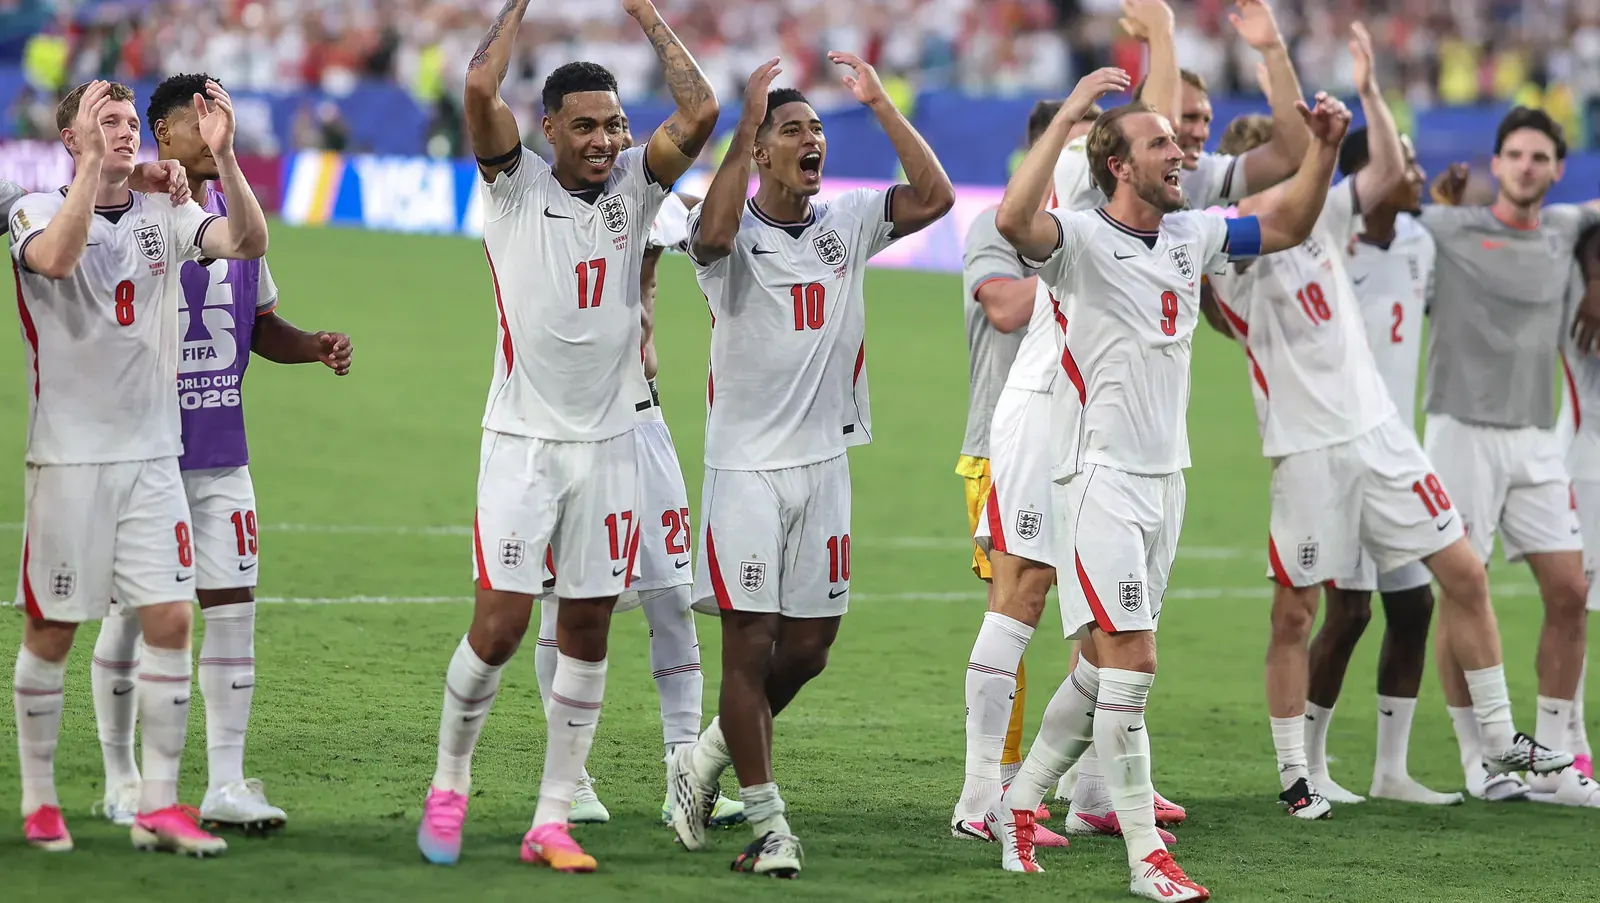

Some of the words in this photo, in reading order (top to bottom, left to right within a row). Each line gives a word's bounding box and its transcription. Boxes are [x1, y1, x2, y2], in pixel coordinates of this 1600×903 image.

[115, 280, 135, 326] 8
[575, 257, 606, 309] 17
[1296, 281, 1332, 327] 18
[790, 282, 825, 331] 10
[1160, 290, 1178, 336] 9
[1390, 301, 1403, 343] 2
[183, 346, 217, 361] FIFA
[176, 377, 211, 390] ORLD
[213, 374, 239, 387] CUP
[179, 388, 240, 410] 026
[1411, 472, 1451, 518] 18
[174, 521, 192, 567] 8
[231, 510, 257, 556] 19
[604, 509, 632, 561] 17
[661, 507, 691, 555] 25
[826, 533, 850, 583] 10
